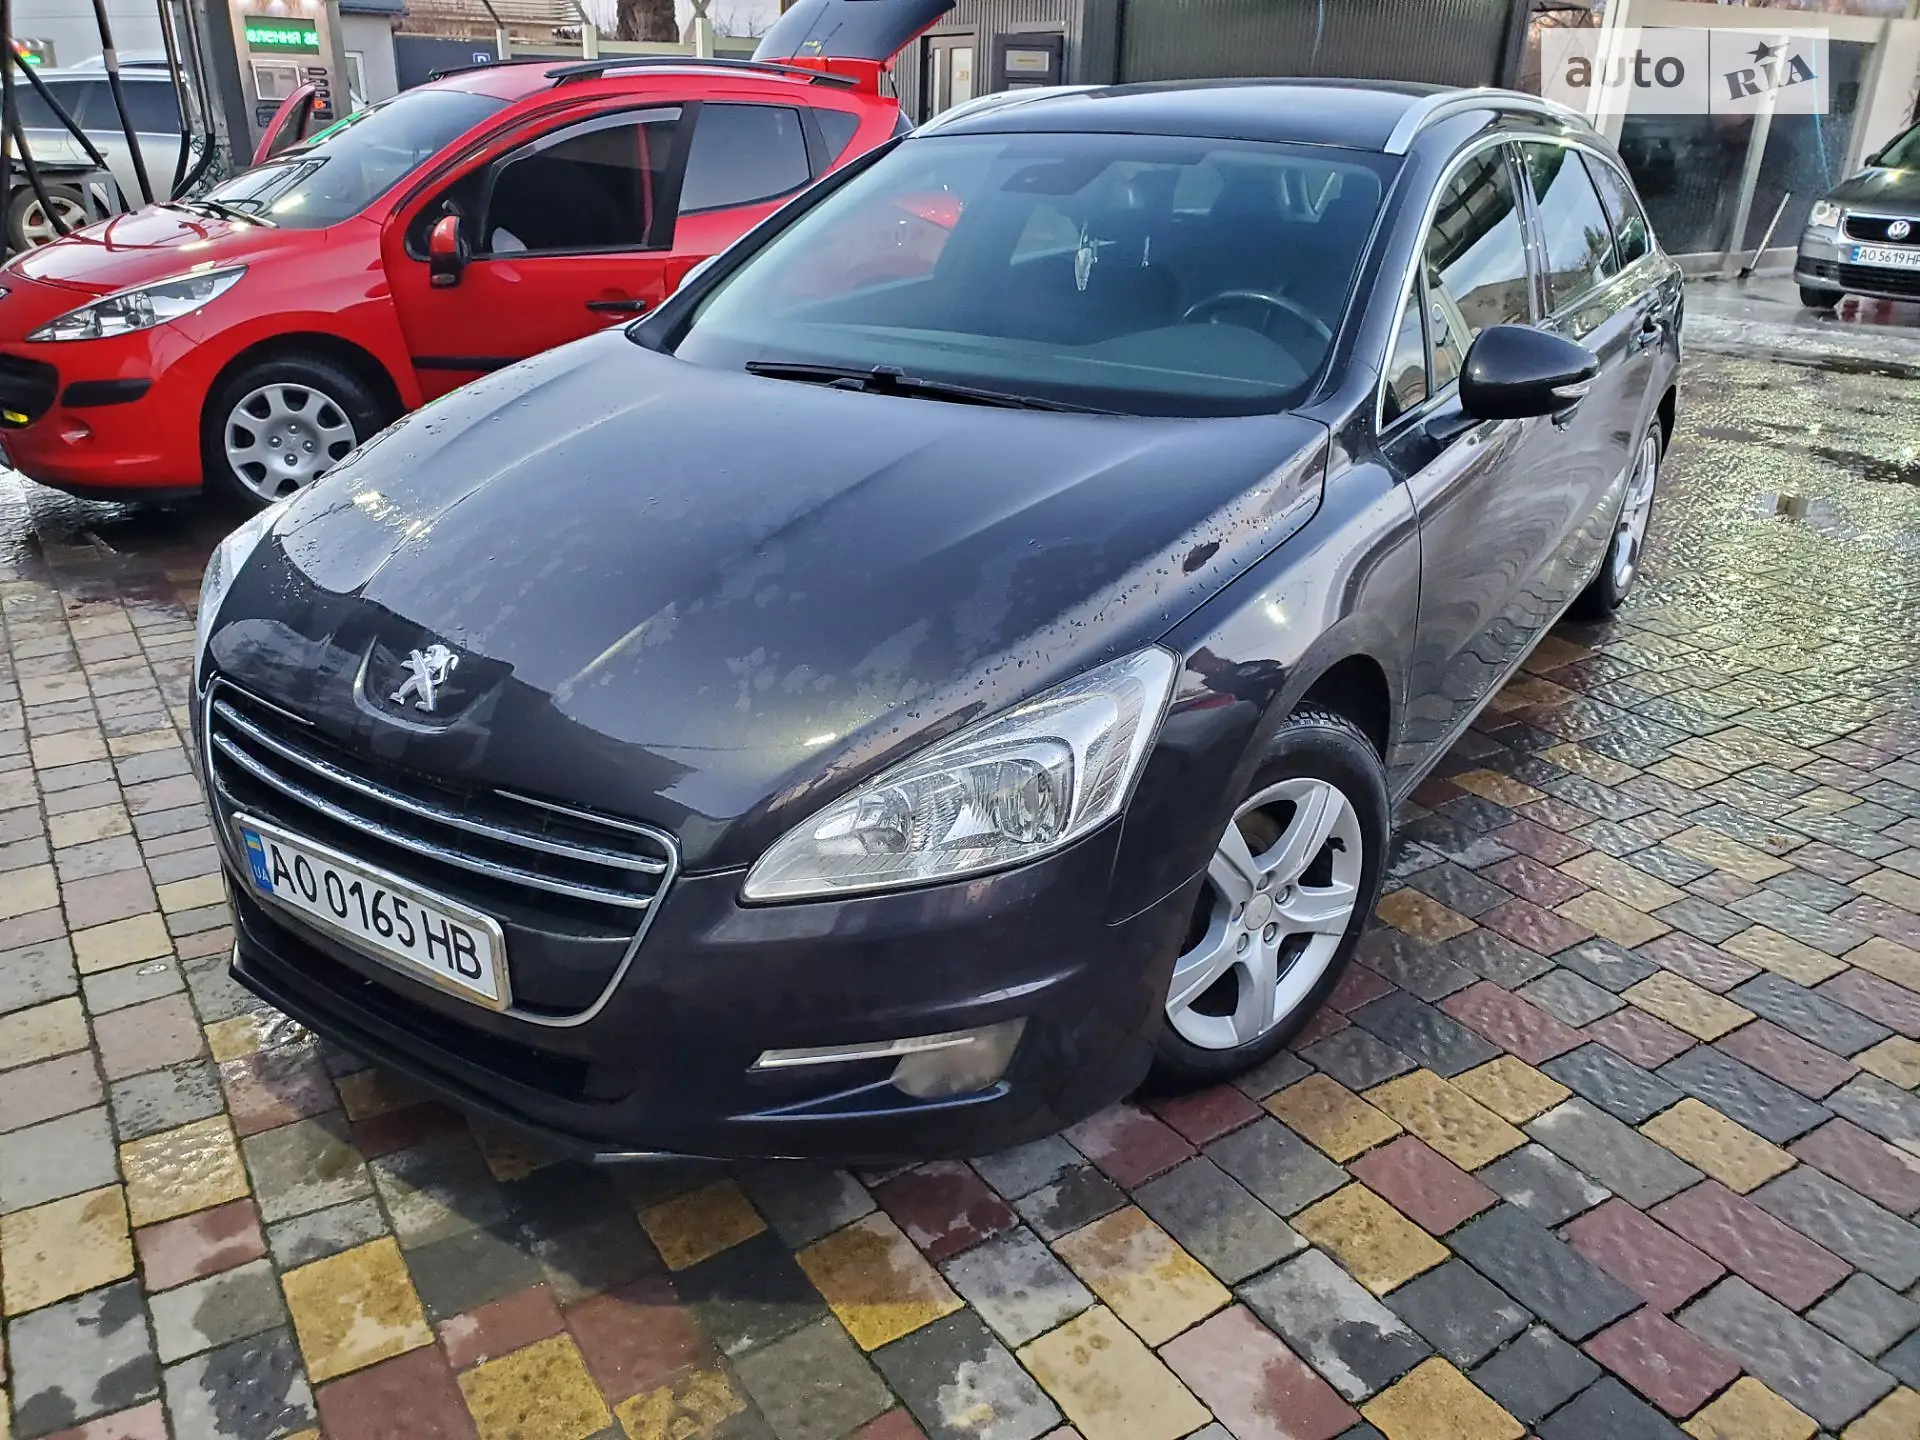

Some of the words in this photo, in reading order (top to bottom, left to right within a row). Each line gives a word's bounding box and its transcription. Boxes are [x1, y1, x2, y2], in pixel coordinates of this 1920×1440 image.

[253, 864, 270, 882] UA
[271, 843, 318, 903] AO
[324, 869, 416, 948] 0165
[420, 909, 483, 980] HB
